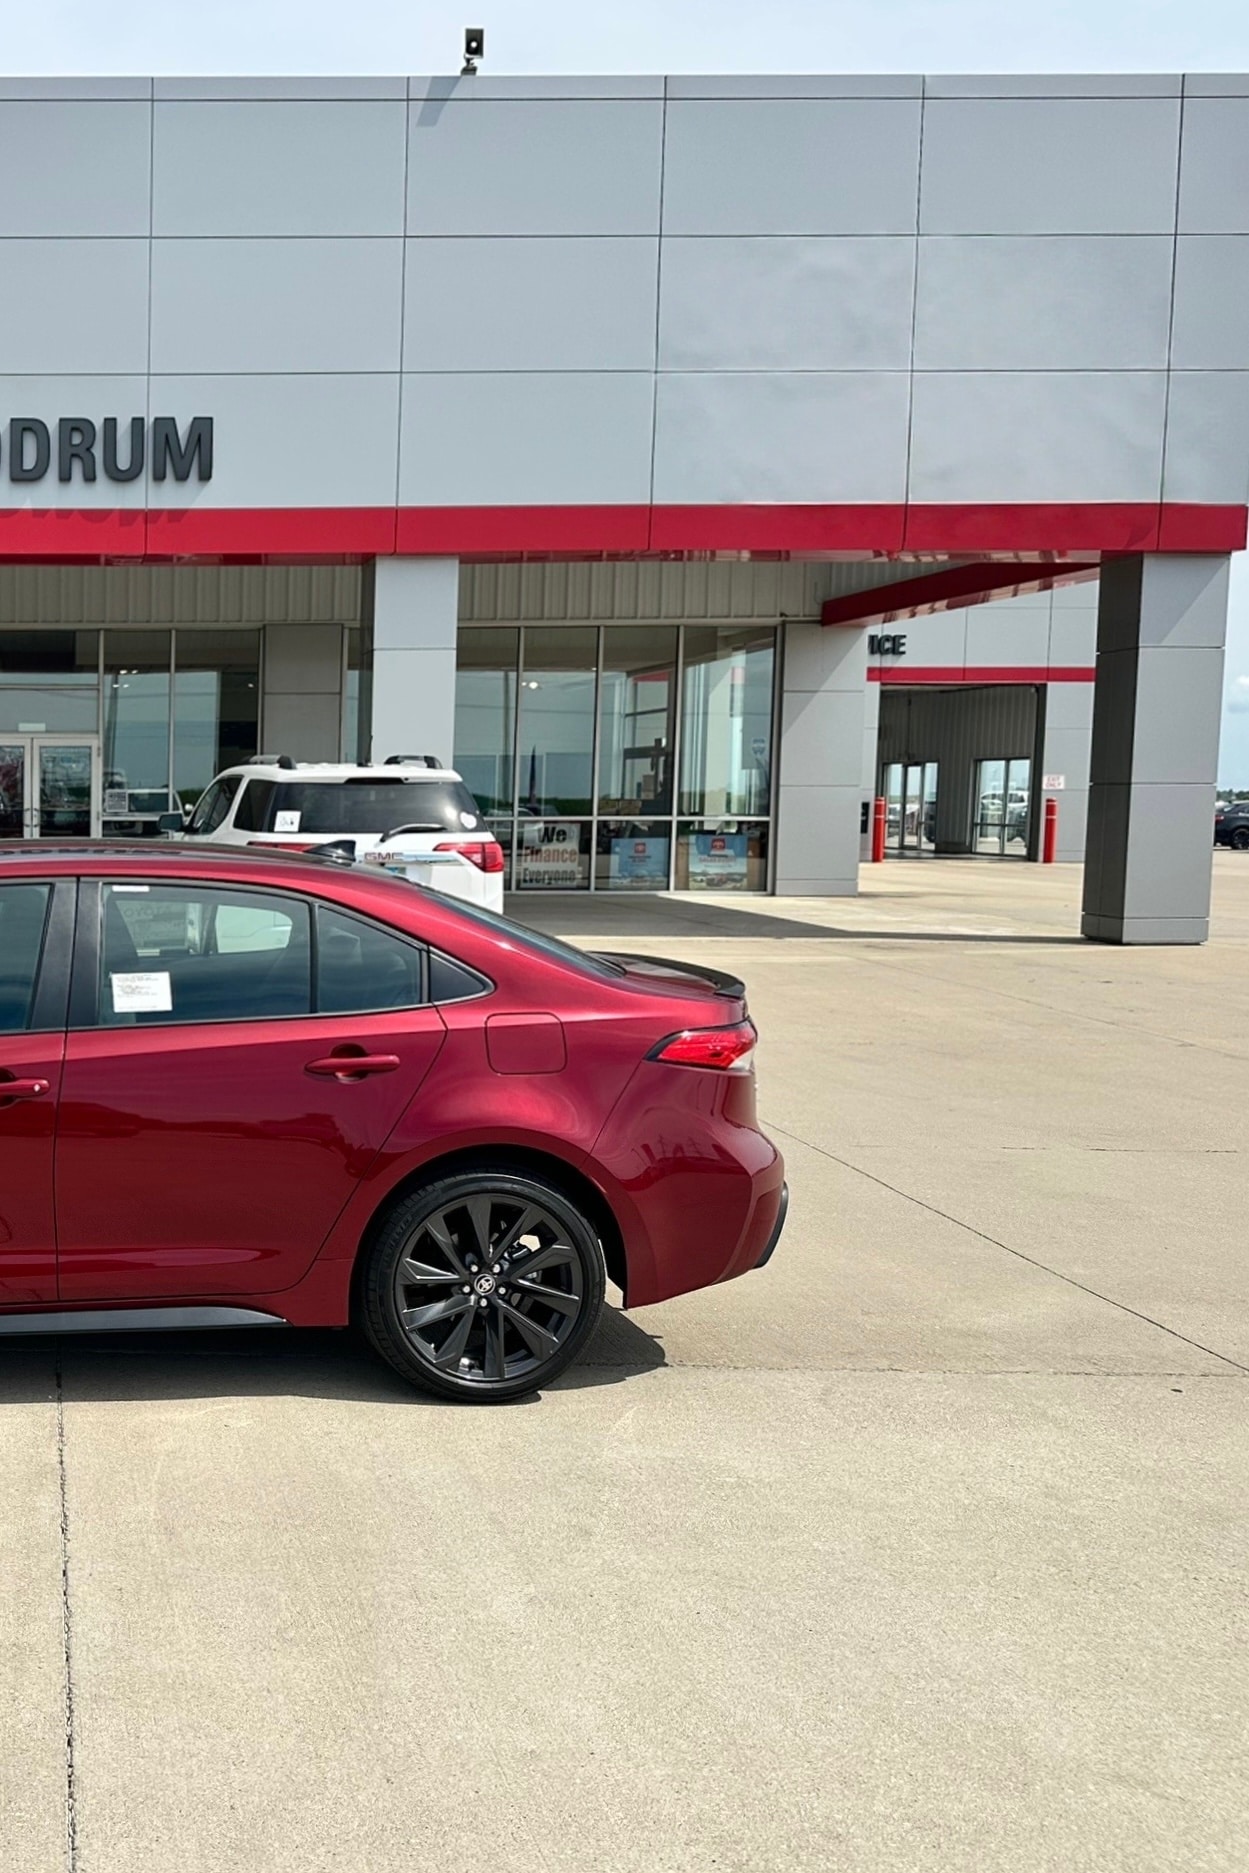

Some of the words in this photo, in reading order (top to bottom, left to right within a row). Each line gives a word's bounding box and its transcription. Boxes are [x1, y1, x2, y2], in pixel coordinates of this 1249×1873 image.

[537, 826, 567, 843] We
[364, 852, 403, 860] GMC
[523, 846, 578, 863] Finance
[522, 868, 576, 885] Everyone
